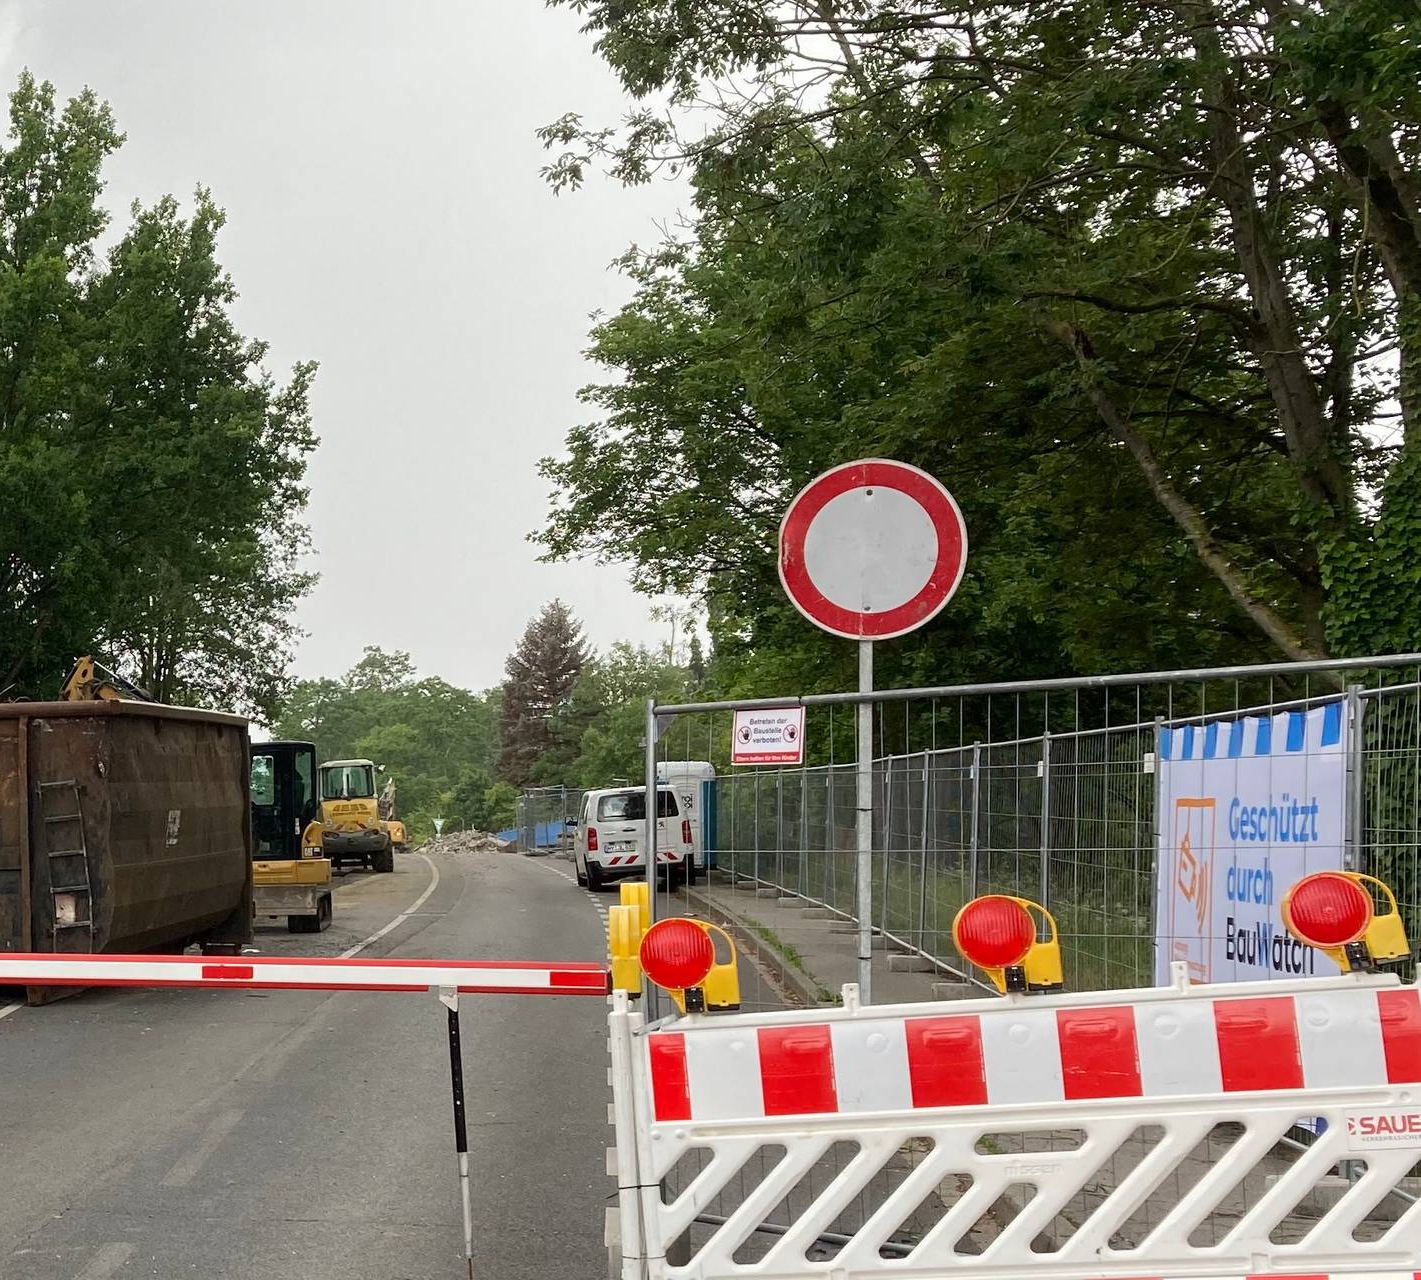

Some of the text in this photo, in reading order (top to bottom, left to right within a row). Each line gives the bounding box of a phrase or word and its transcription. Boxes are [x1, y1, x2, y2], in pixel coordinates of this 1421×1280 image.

[749, 718, 776, 726] Betreten
[1229, 793, 1319, 842] Geschützt
[1227, 856, 1274, 906] durch
[1226, 917, 1315, 975] BauWatch
[1359, 1114, 1421, 1135] SAUE
